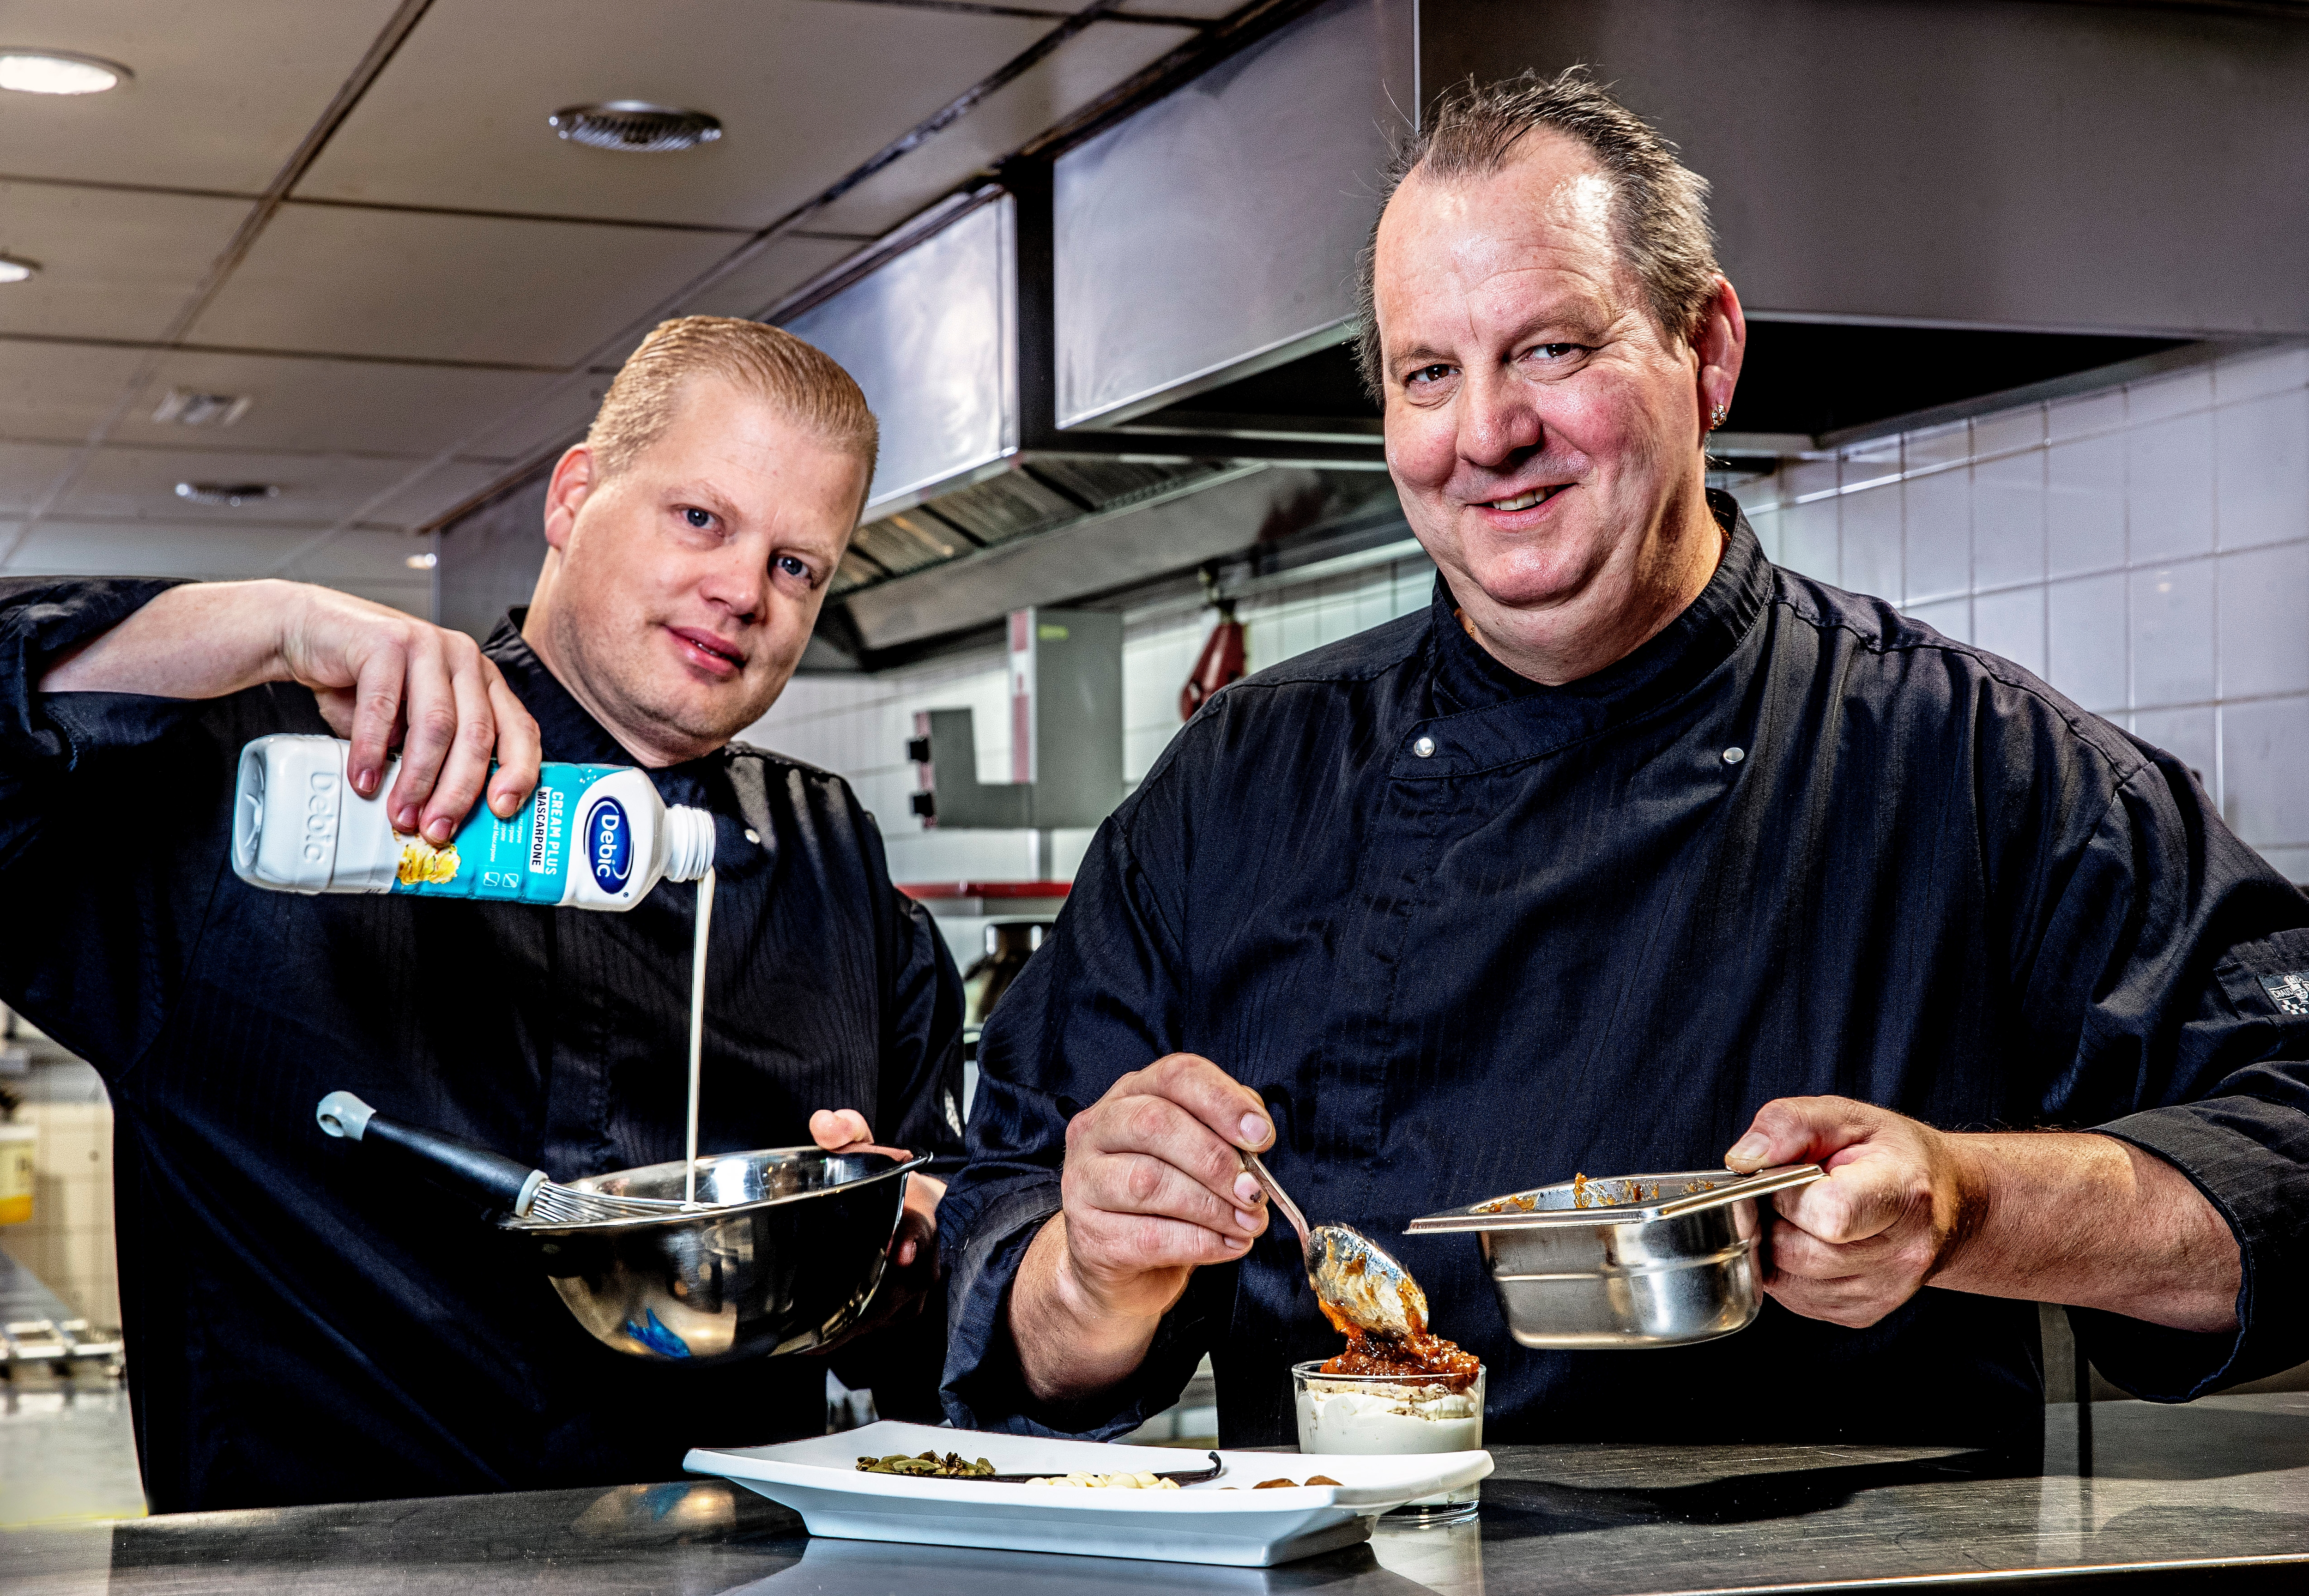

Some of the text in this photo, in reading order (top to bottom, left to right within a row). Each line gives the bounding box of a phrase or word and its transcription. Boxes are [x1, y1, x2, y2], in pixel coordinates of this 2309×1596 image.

[304, 771, 340, 864] Debic
[490, 830, 499, 862] Mascarpone
[532, 791, 547, 865] MASCARPONE
[545, 792, 564, 875] CREAM PLUS
[596, 814, 620, 877] Debic
[2272, 987, 2294, 998] CHAUD
